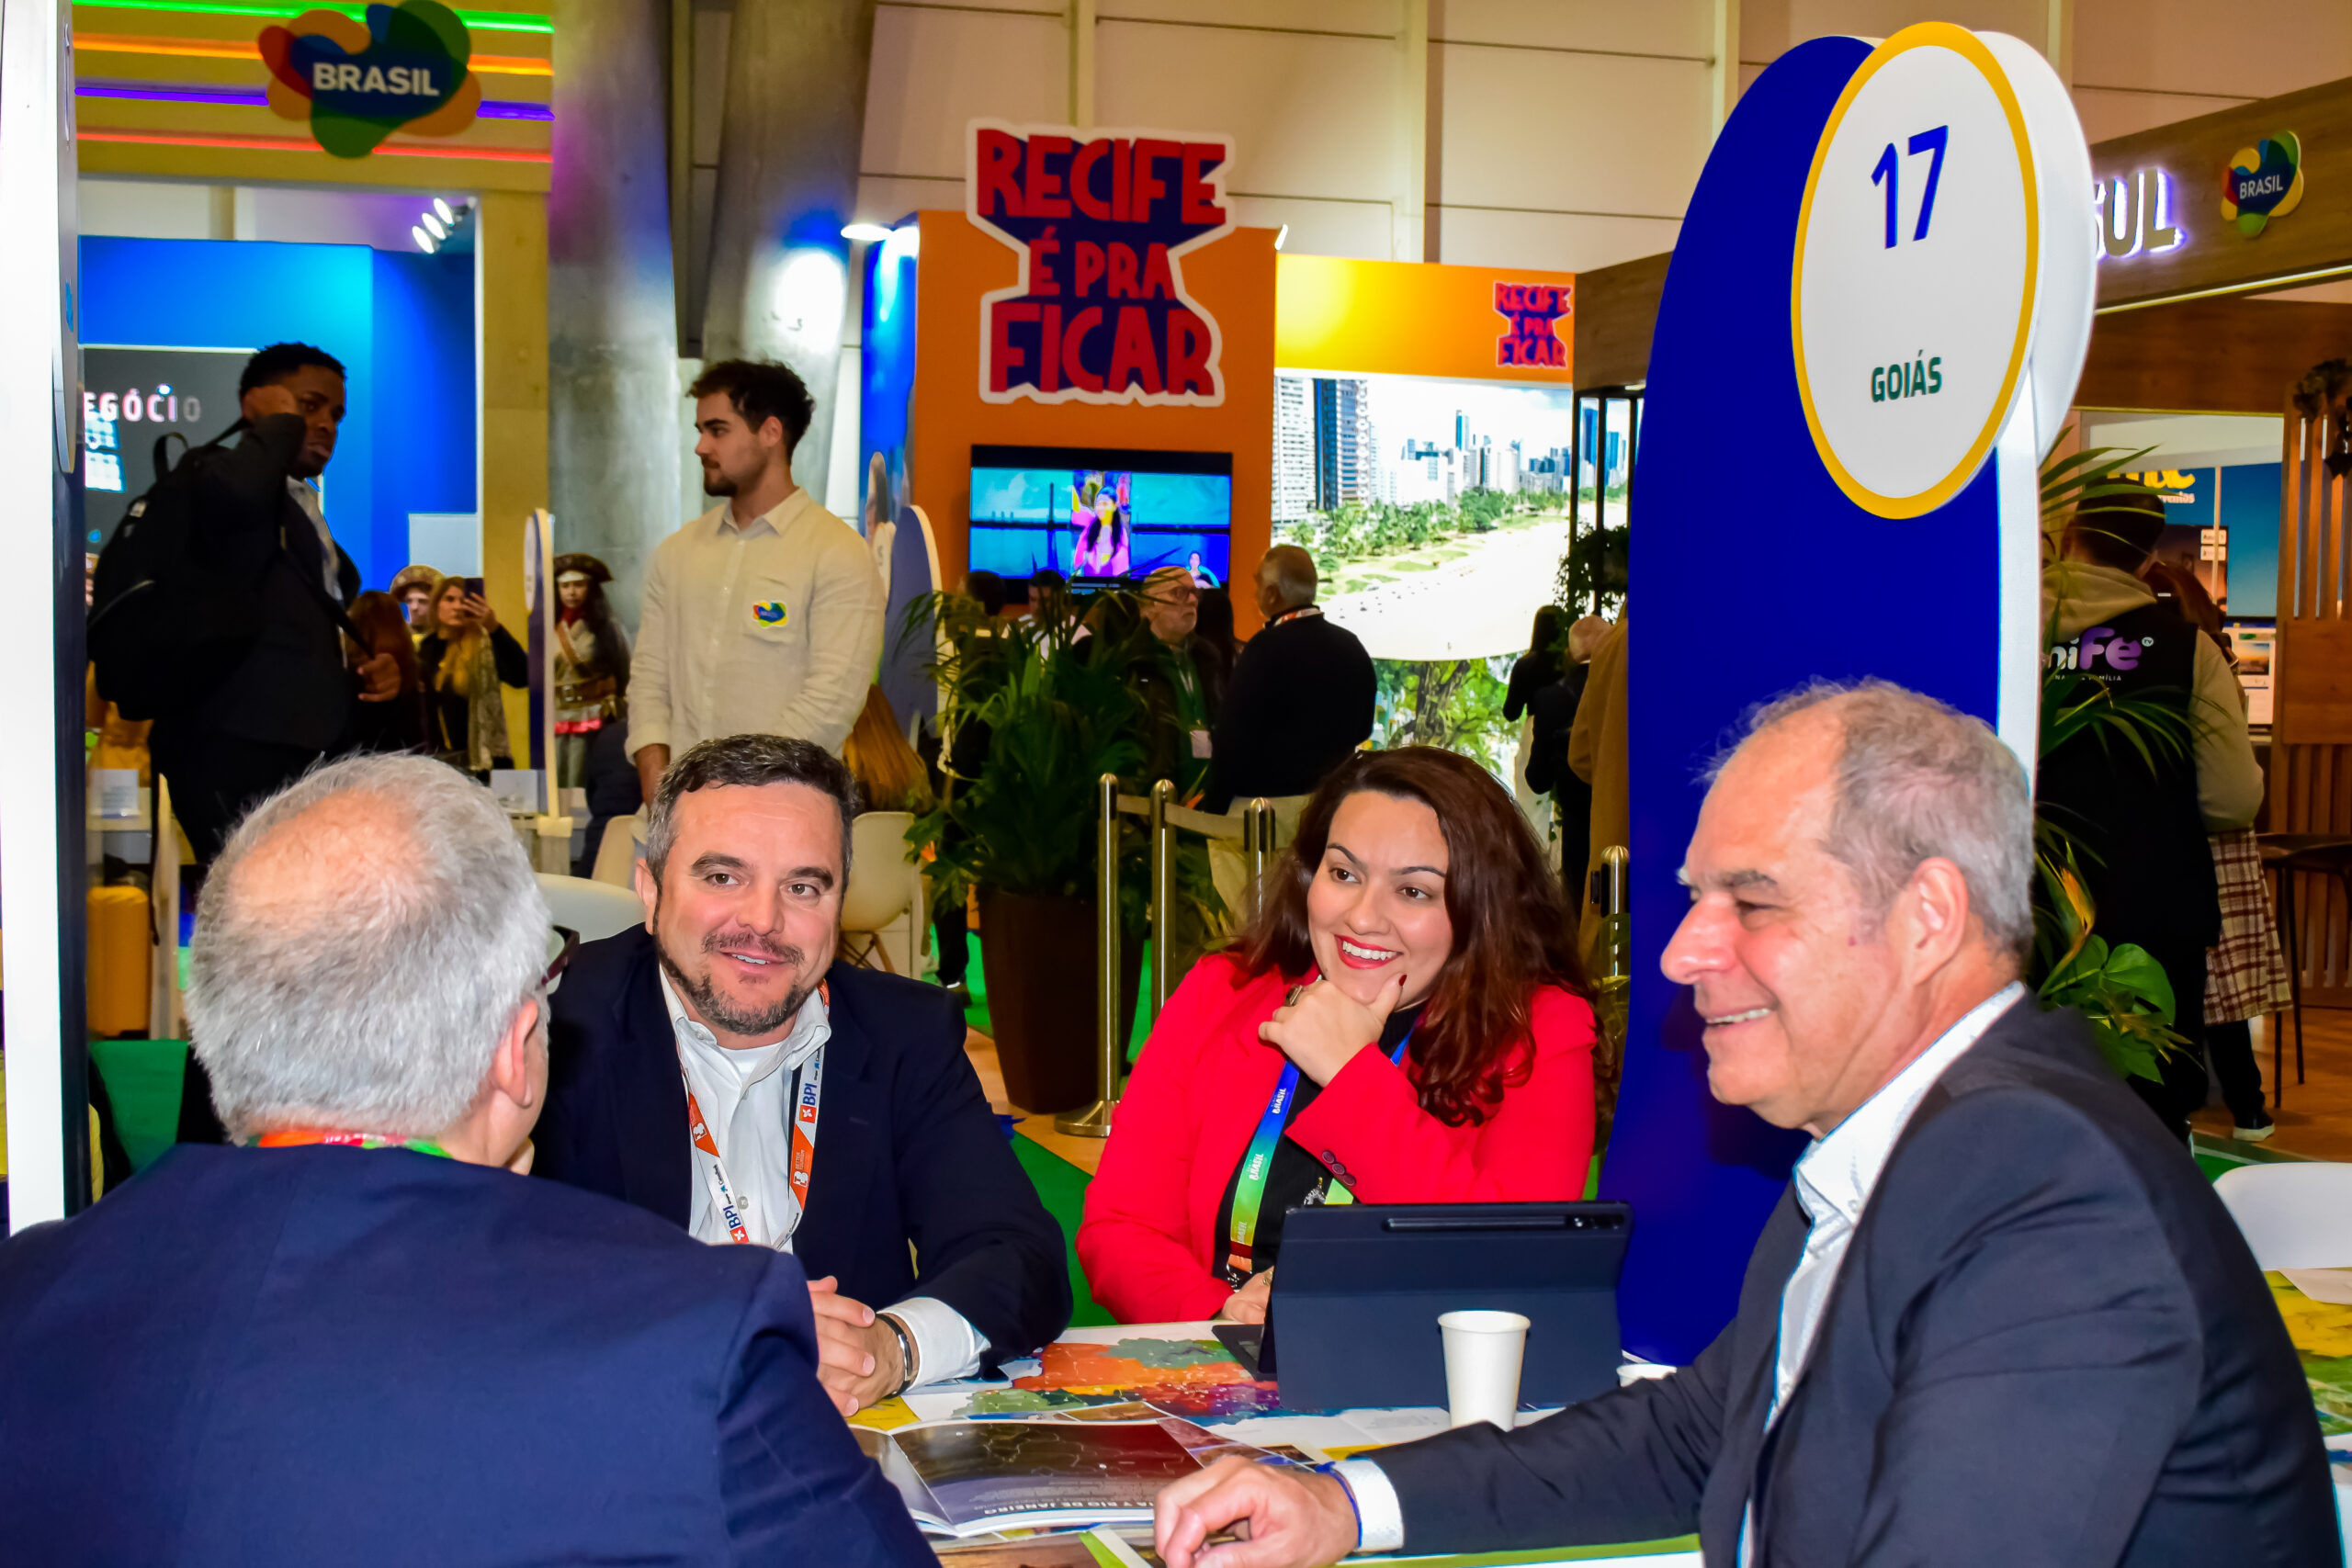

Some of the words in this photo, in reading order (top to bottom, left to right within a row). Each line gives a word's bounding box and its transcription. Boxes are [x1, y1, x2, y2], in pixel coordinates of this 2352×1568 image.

[313, 62, 440, 96] BRASIL
[977, 129, 1227, 225] RECIFE
[1871, 125, 1949, 249] 17
[2239, 175, 2284, 199] BRASIL
[1028, 226, 1060, 296] É
[1075, 241, 1178, 300] PRA
[1495, 283, 1571, 314] RECIFE
[989, 302, 1216, 396] FICAR
[1498, 337, 1566, 367] FICAR
[1871, 349, 1942, 402] GOIÁS
[803, 1083, 818, 1106] BPI
[1272, 1088, 1287, 1114] BRASIL
[1249, 1153, 1264, 1181] BRASIL
[723, 1205, 741, 1229] BPI
[984, 1502, 1056, 1515] JANEIRO
